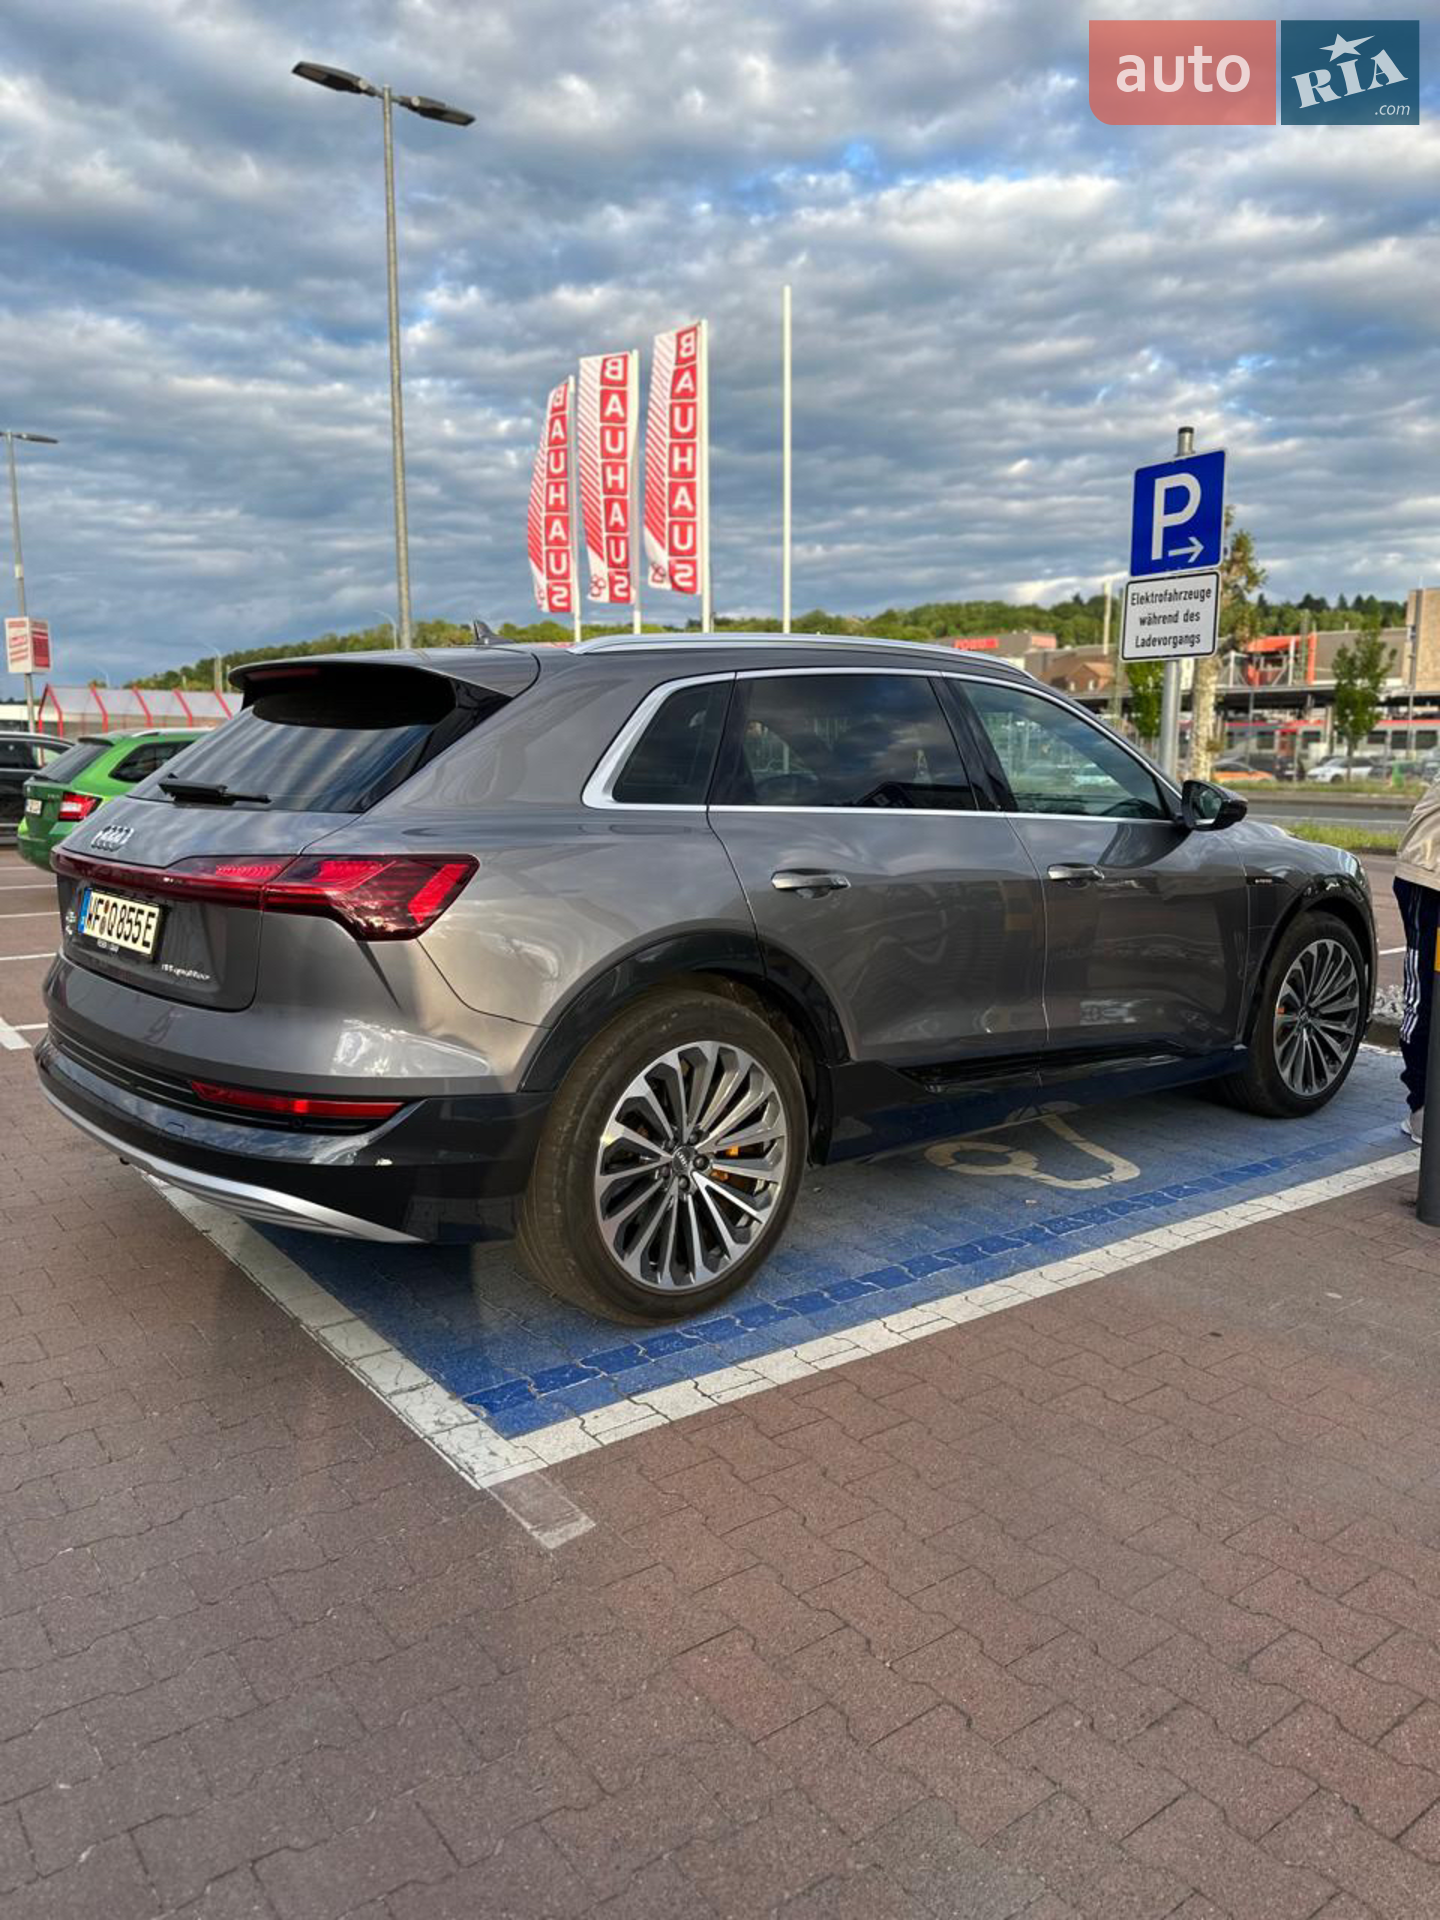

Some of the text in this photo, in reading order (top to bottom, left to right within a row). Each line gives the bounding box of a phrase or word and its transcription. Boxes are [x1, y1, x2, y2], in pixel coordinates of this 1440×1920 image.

[1151, 473, 1202, 560] P
[1130, 587, 1212, 606] Elektrofahrzeuge
[1139, 609, 1201, 627] während des
[1135, 632, 1201, 649] Ladevorgangs
